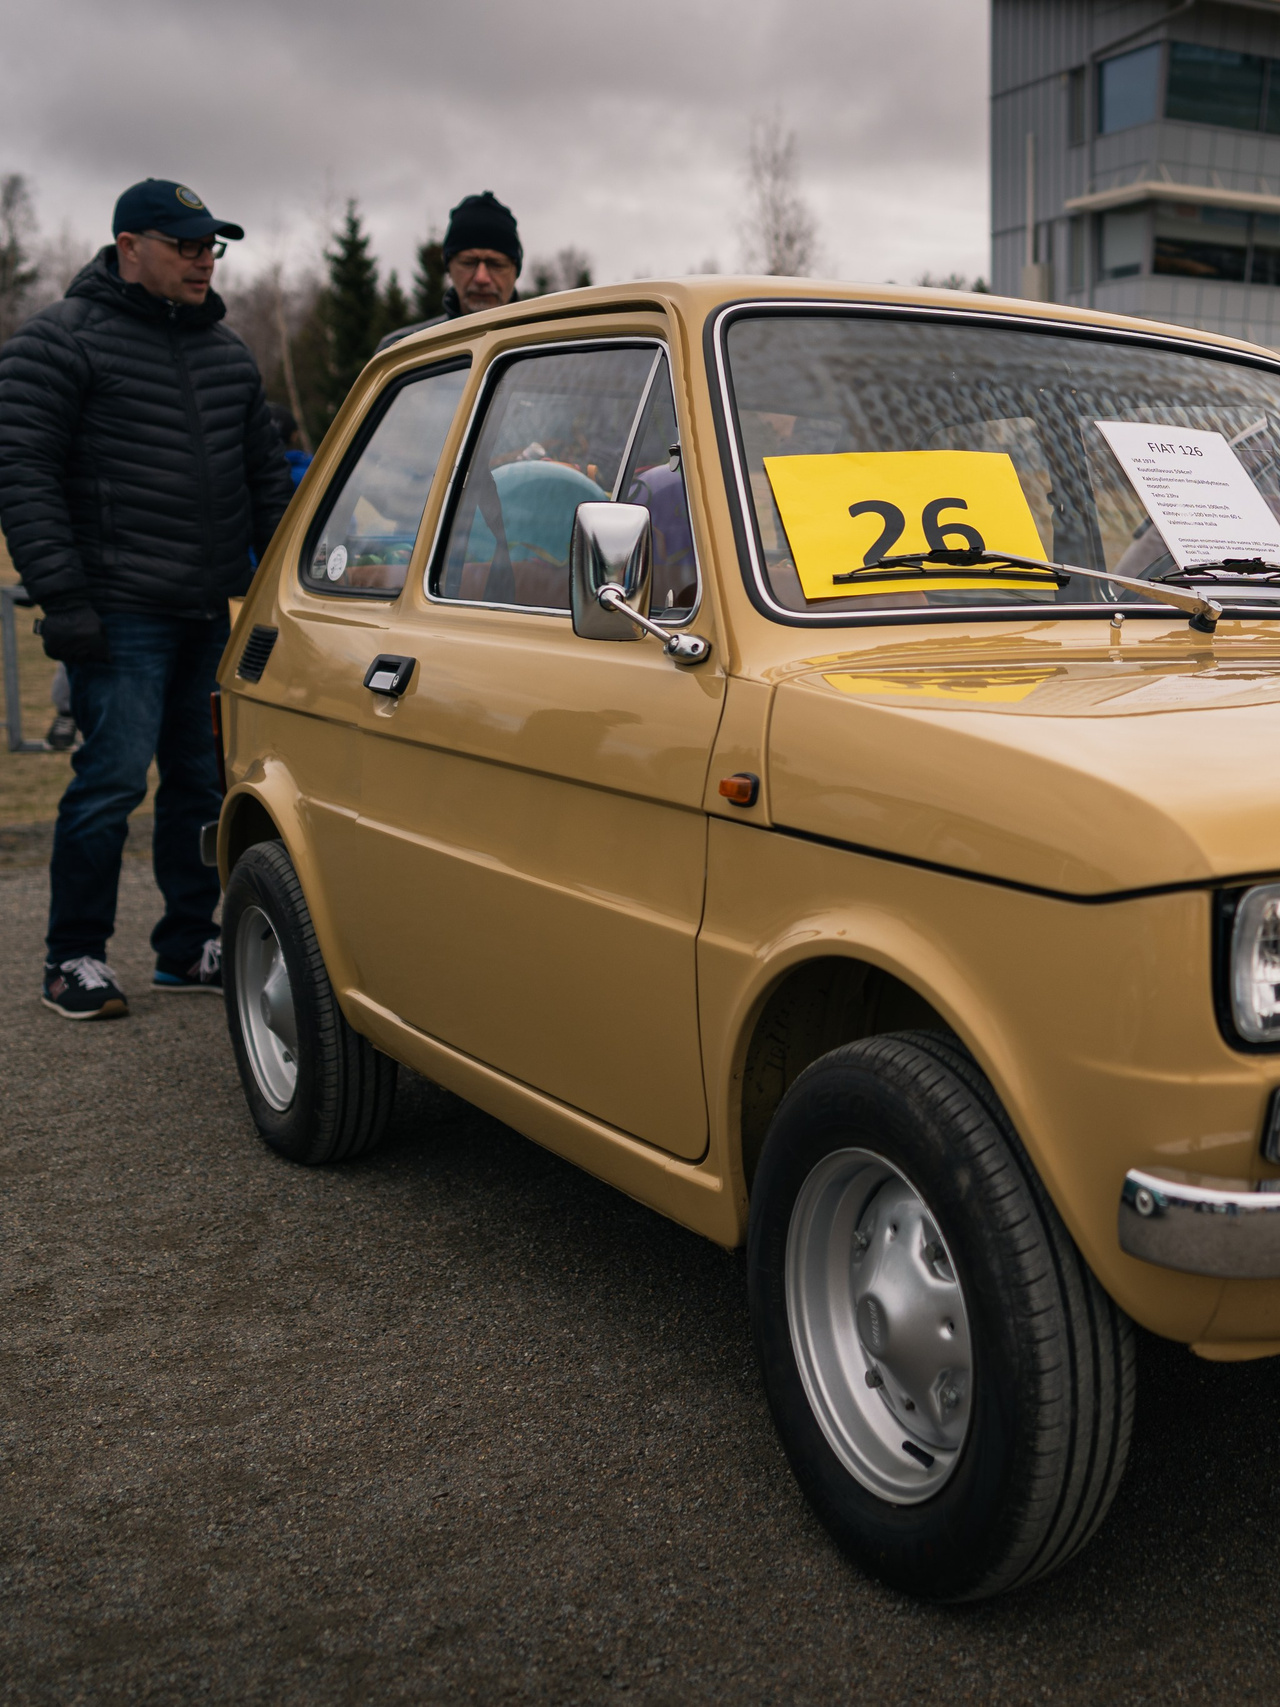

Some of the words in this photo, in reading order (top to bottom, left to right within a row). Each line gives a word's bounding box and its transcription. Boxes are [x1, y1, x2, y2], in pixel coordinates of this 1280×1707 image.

[1147, 442, 1176, 454] FIAT
[1179, 445, 1203, 457] 126
[849, 497, 985, 567] 26
